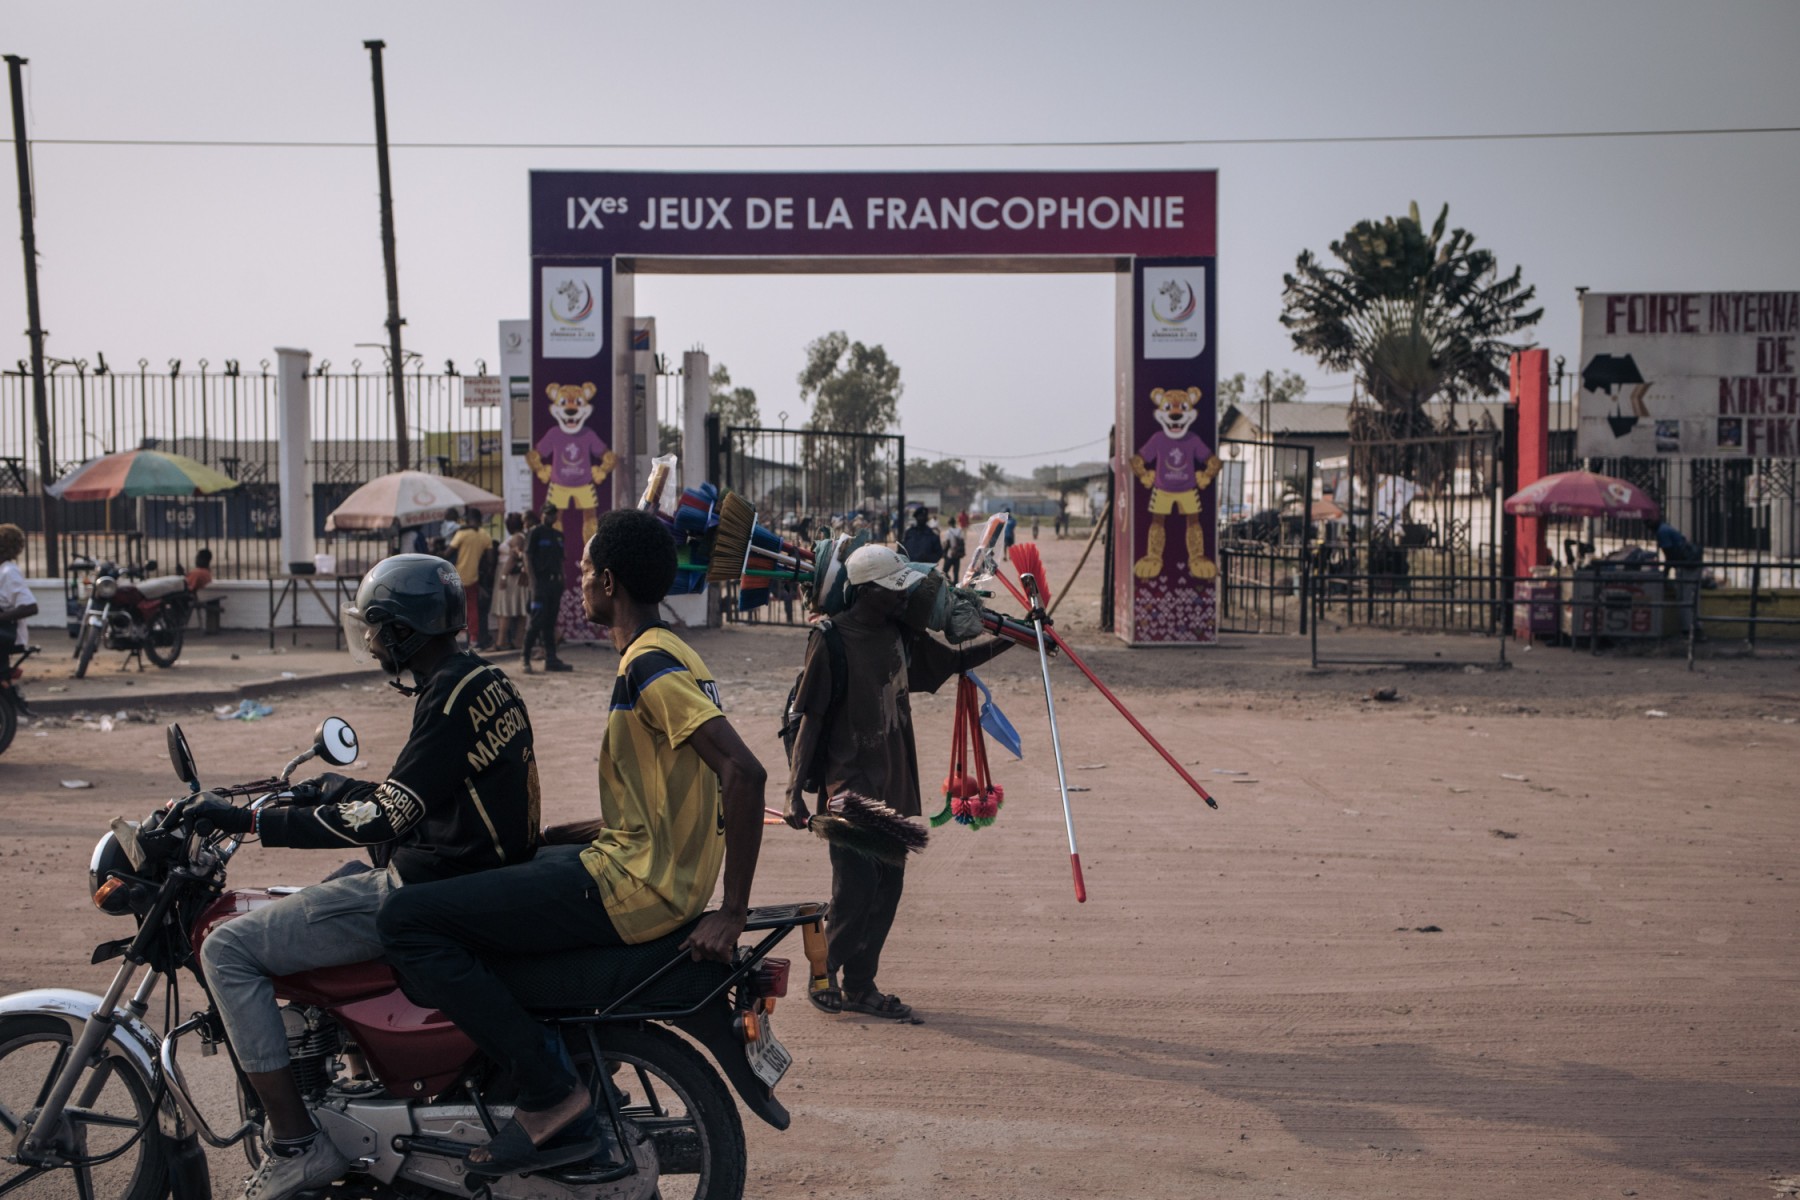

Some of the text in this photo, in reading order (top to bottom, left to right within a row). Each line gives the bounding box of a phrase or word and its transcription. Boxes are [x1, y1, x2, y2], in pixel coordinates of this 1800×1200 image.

[567, 196, 1184, 230] IXes JEUX DE LA FRANCOPHONIE
[1606, 294, 1700, 334] FOIRE
[1756, 336, 1796, 374] DE
[1747, 417, 1800, 456] FIK
